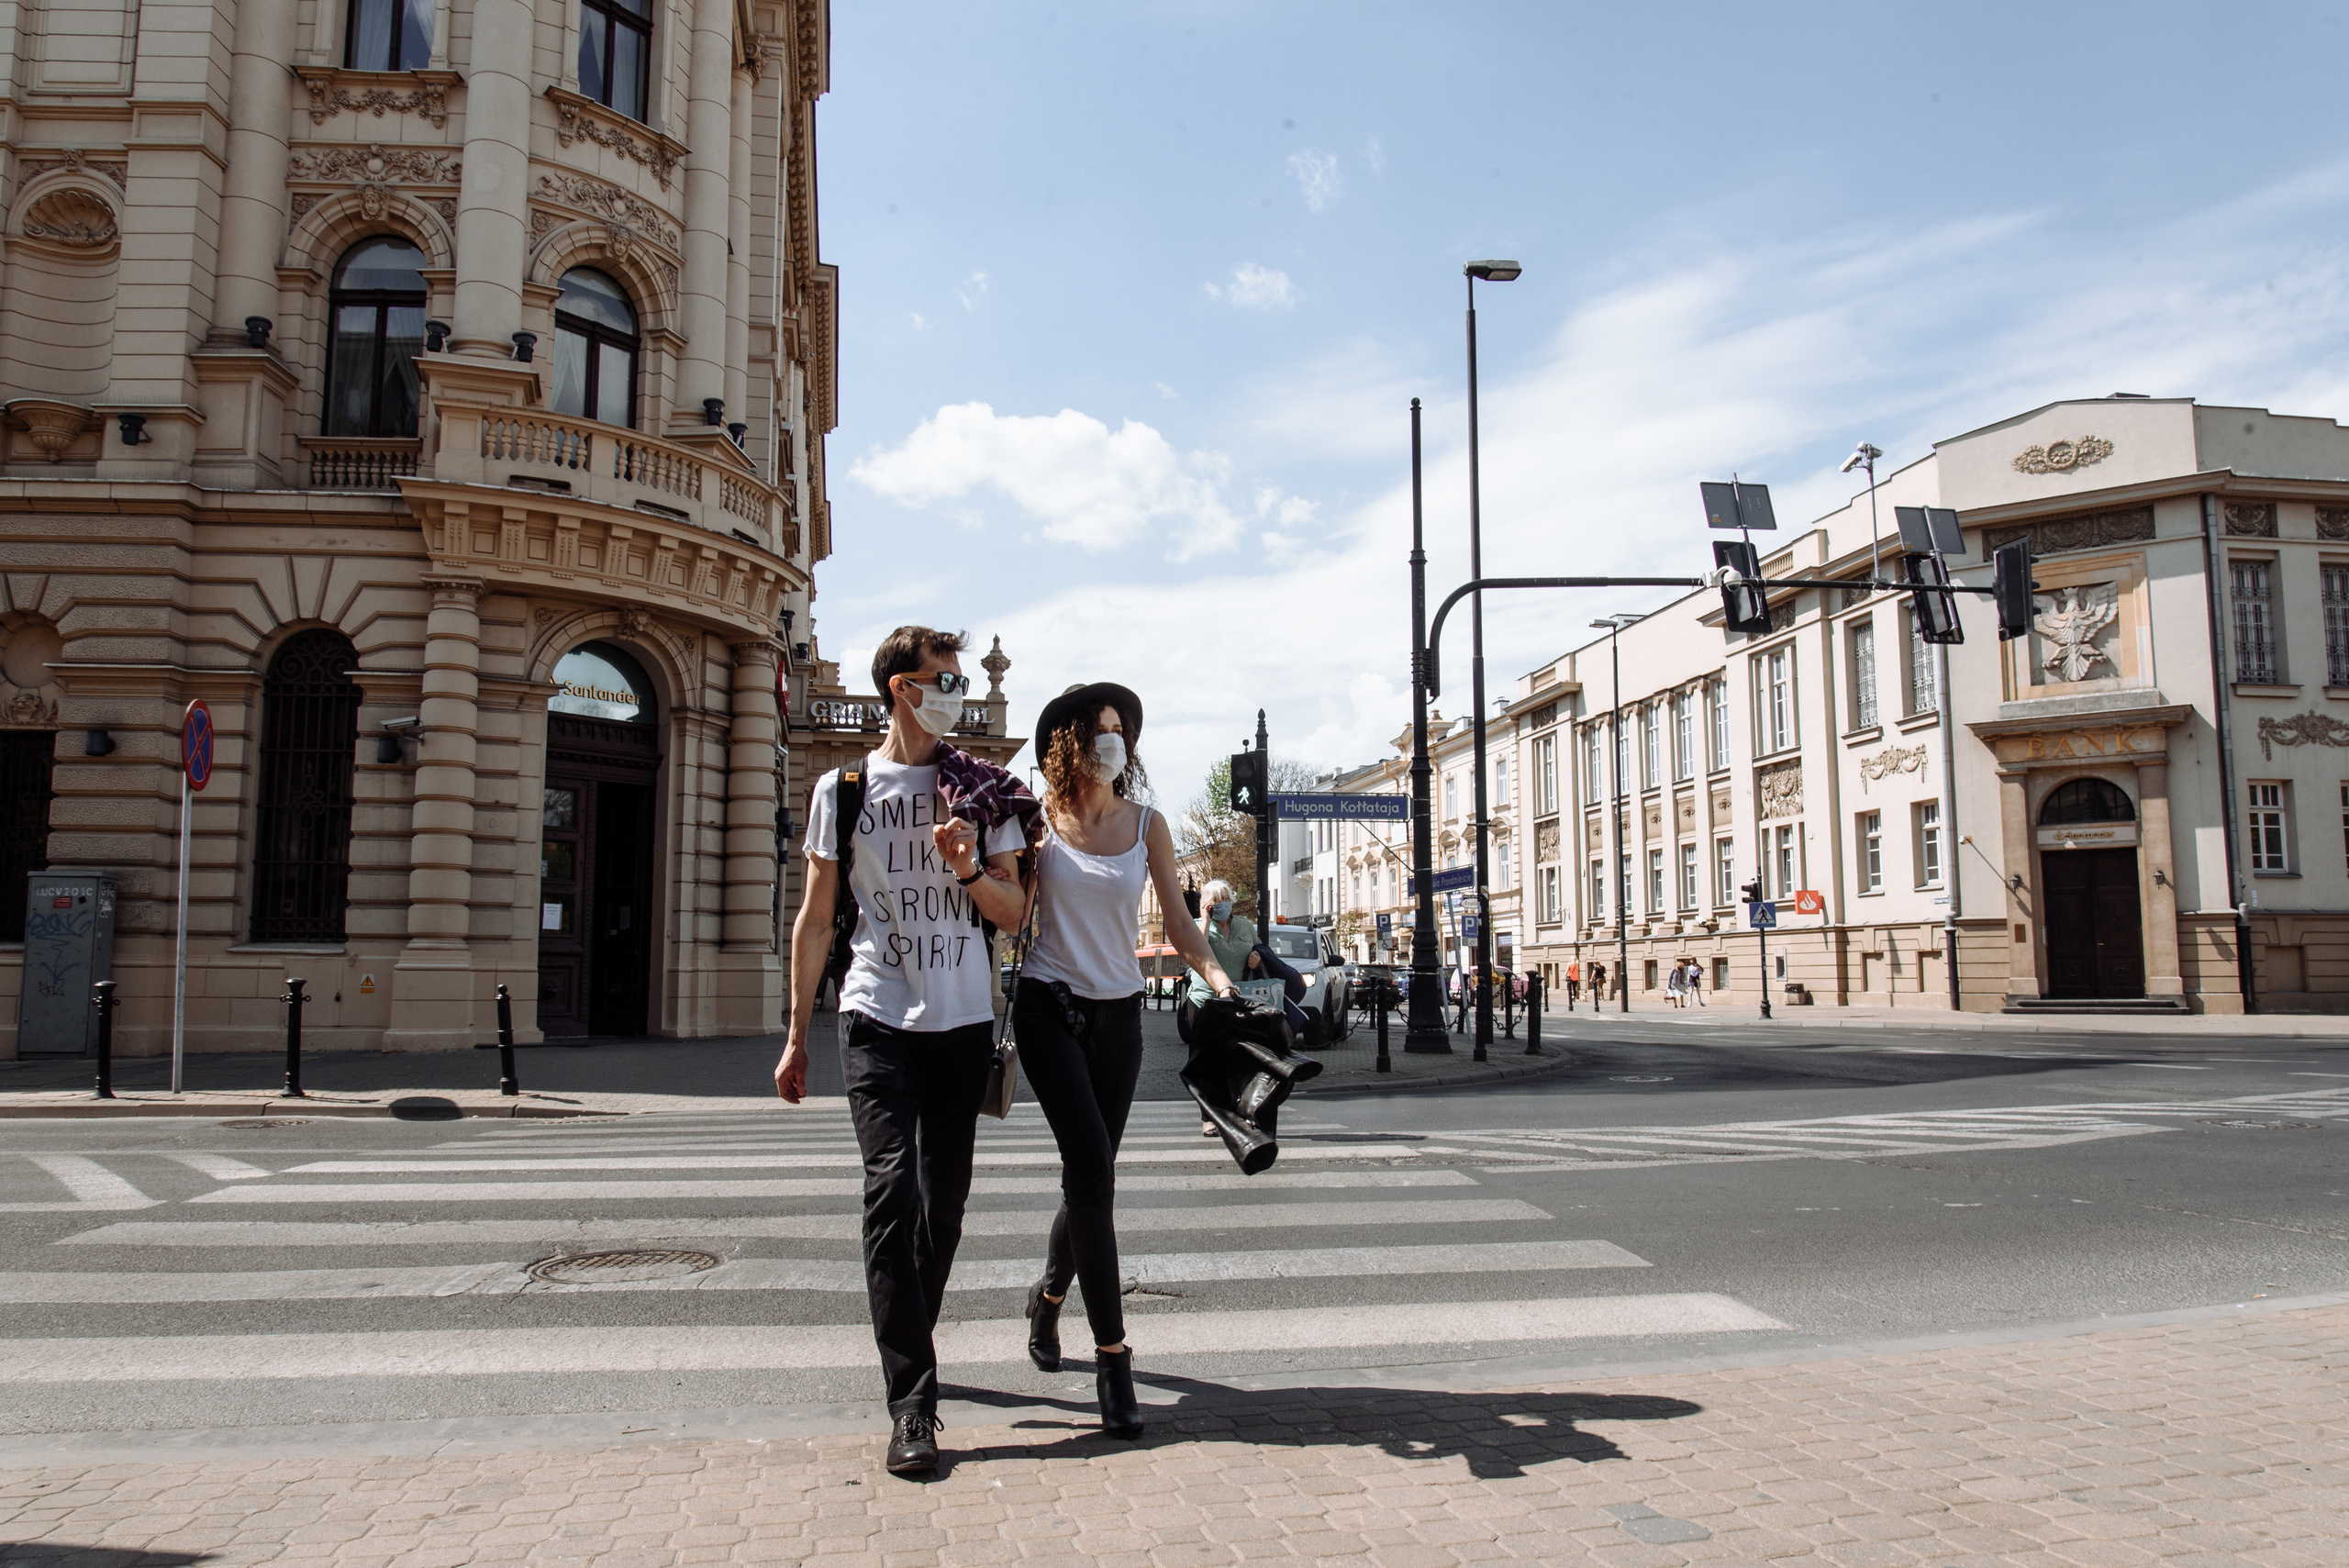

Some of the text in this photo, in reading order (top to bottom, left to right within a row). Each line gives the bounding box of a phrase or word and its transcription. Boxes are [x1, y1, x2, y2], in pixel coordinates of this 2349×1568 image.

[564, 681, 641, 705] Santander
[2028, 731, 2138, 759] BANK
[859, 793, 949, 835] SMEL
[1285, 800, 1400, 816] Hugona Kołłątaja
[2065, 829, 2115, 840] Santander
[874, 886, 974, 922] SRON
[1379, 915, 1388, 928] P
[1464, 917, 1475, 931] P
[884, 933, 971, 971] SPIRIT
